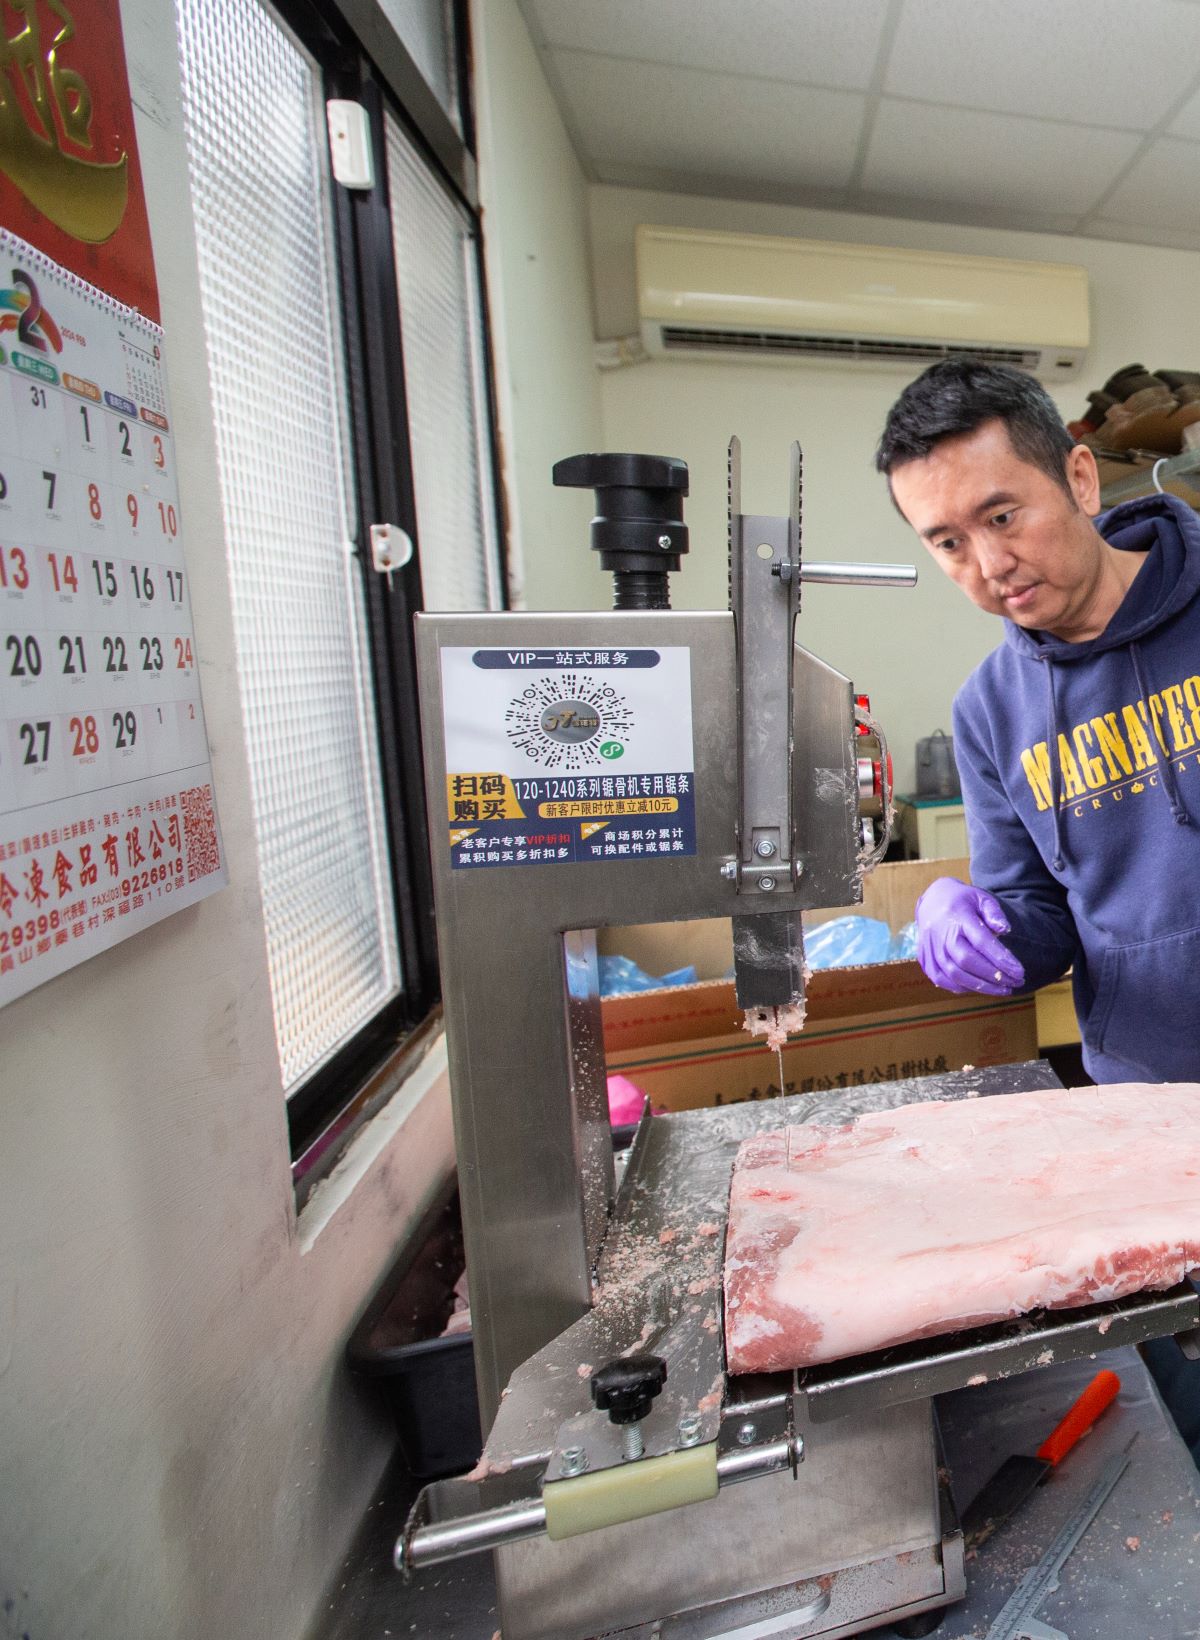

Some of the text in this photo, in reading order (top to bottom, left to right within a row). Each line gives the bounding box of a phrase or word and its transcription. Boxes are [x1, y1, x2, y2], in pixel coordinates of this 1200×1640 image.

[30, 386, 46, 408] 31
[80, 406, 90, 442] 1
[119, 421, 132, 456] 2
[153, 435, 164, 467] 3
[42, 471, 56, 509] 7
[88, 483, 101, 520] 8
[127, 494, 138, 527] 9
[158, 502, 177, 536] 10
[0, 546, 183, 602] 13 14 15 16 17
[6, 634, 193, 676] 20 21 22 23 24
[507, 651, 629, 666] VIP一站式服务
[20, 704, 195, 765] 27 28 29 1 2
[452, 775, 505, 797] 扫码
[514, 774, 689, 800] 120-1240系列锯骨机专用锯条
[454, 799, 506, 821] 购买
[546, 799, 672, 817] 新客户限时优惠立减10元
[604, 827, 684, 842] 商场积分累计
[459, 847, 569, 864] 累积购买多折扣多
[591, 841, 684, 856] 可换配件或锯条
